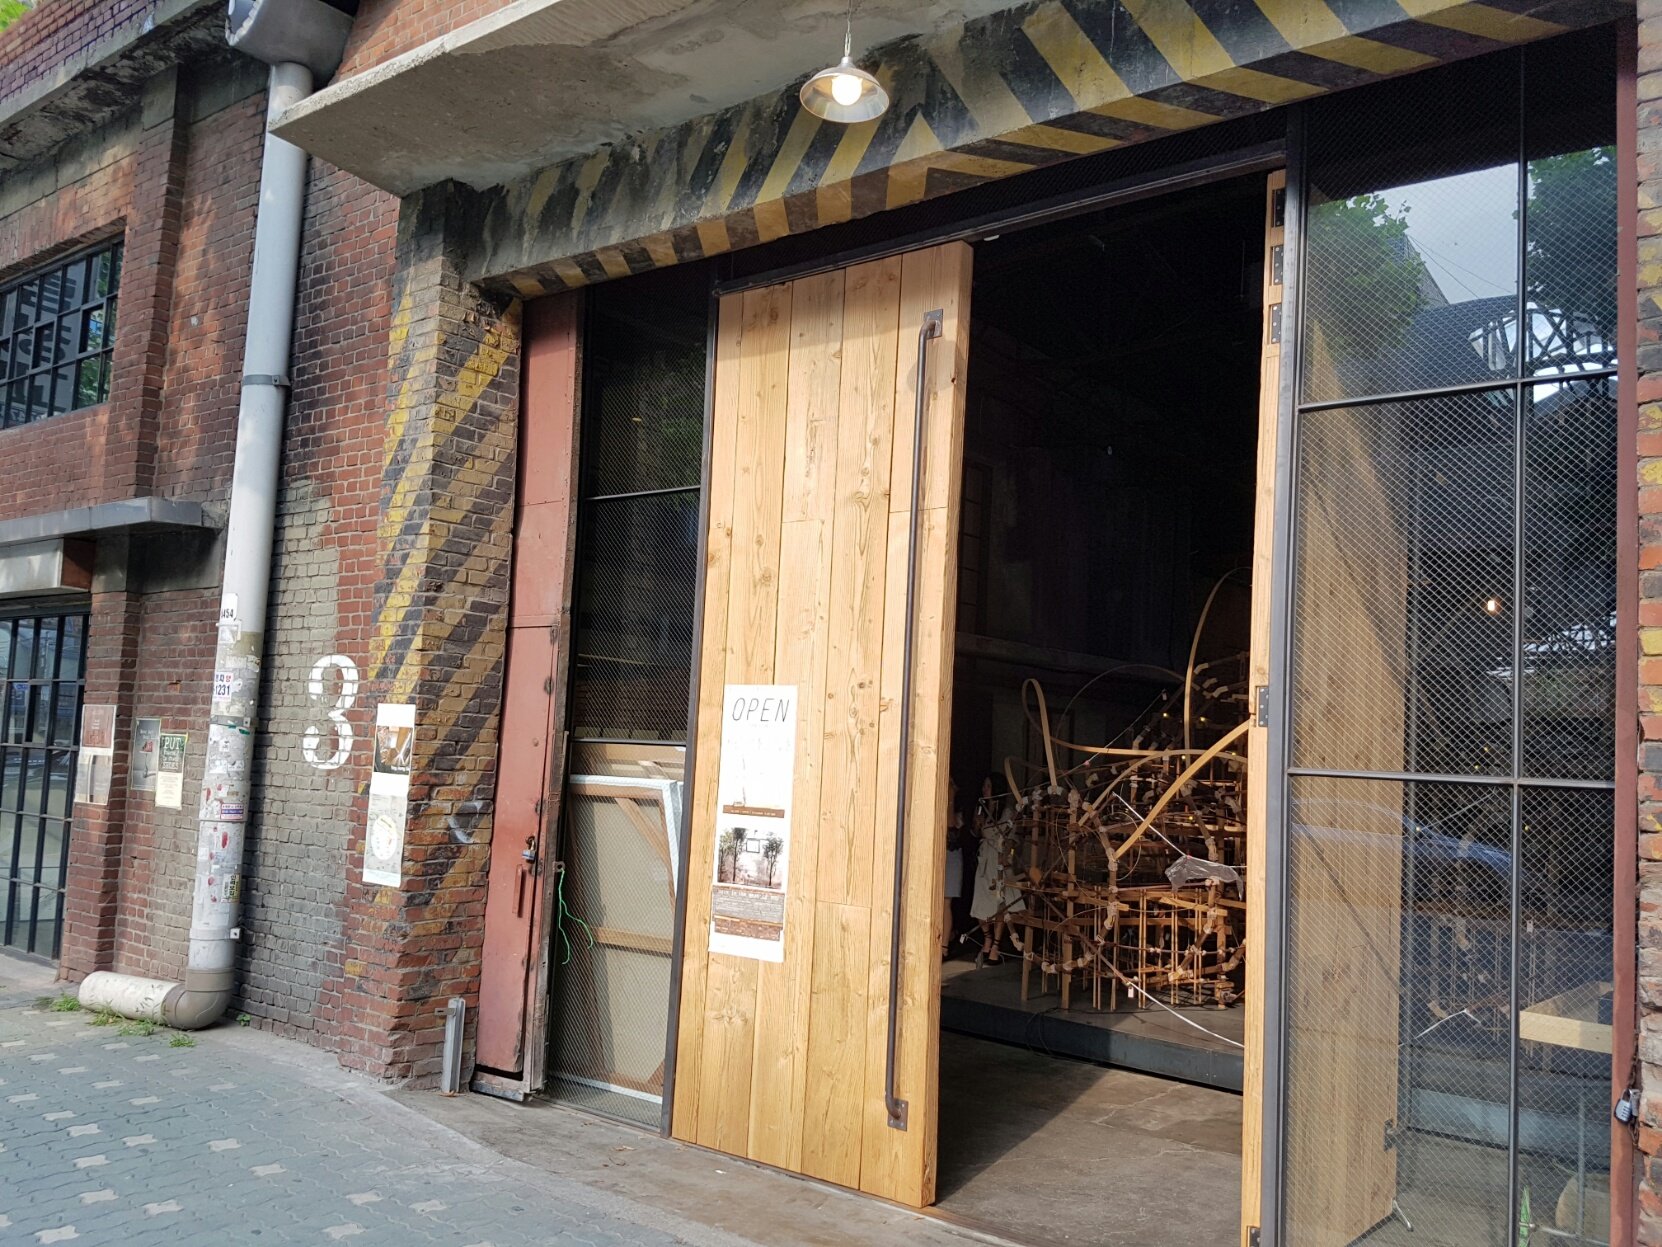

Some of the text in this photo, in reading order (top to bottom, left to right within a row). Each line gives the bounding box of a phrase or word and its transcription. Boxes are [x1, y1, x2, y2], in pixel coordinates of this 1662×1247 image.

[303, 655, 359, 770] 3
[732, 697, 790, 722] OPEN
[163, 737, 182, 750] PUT
